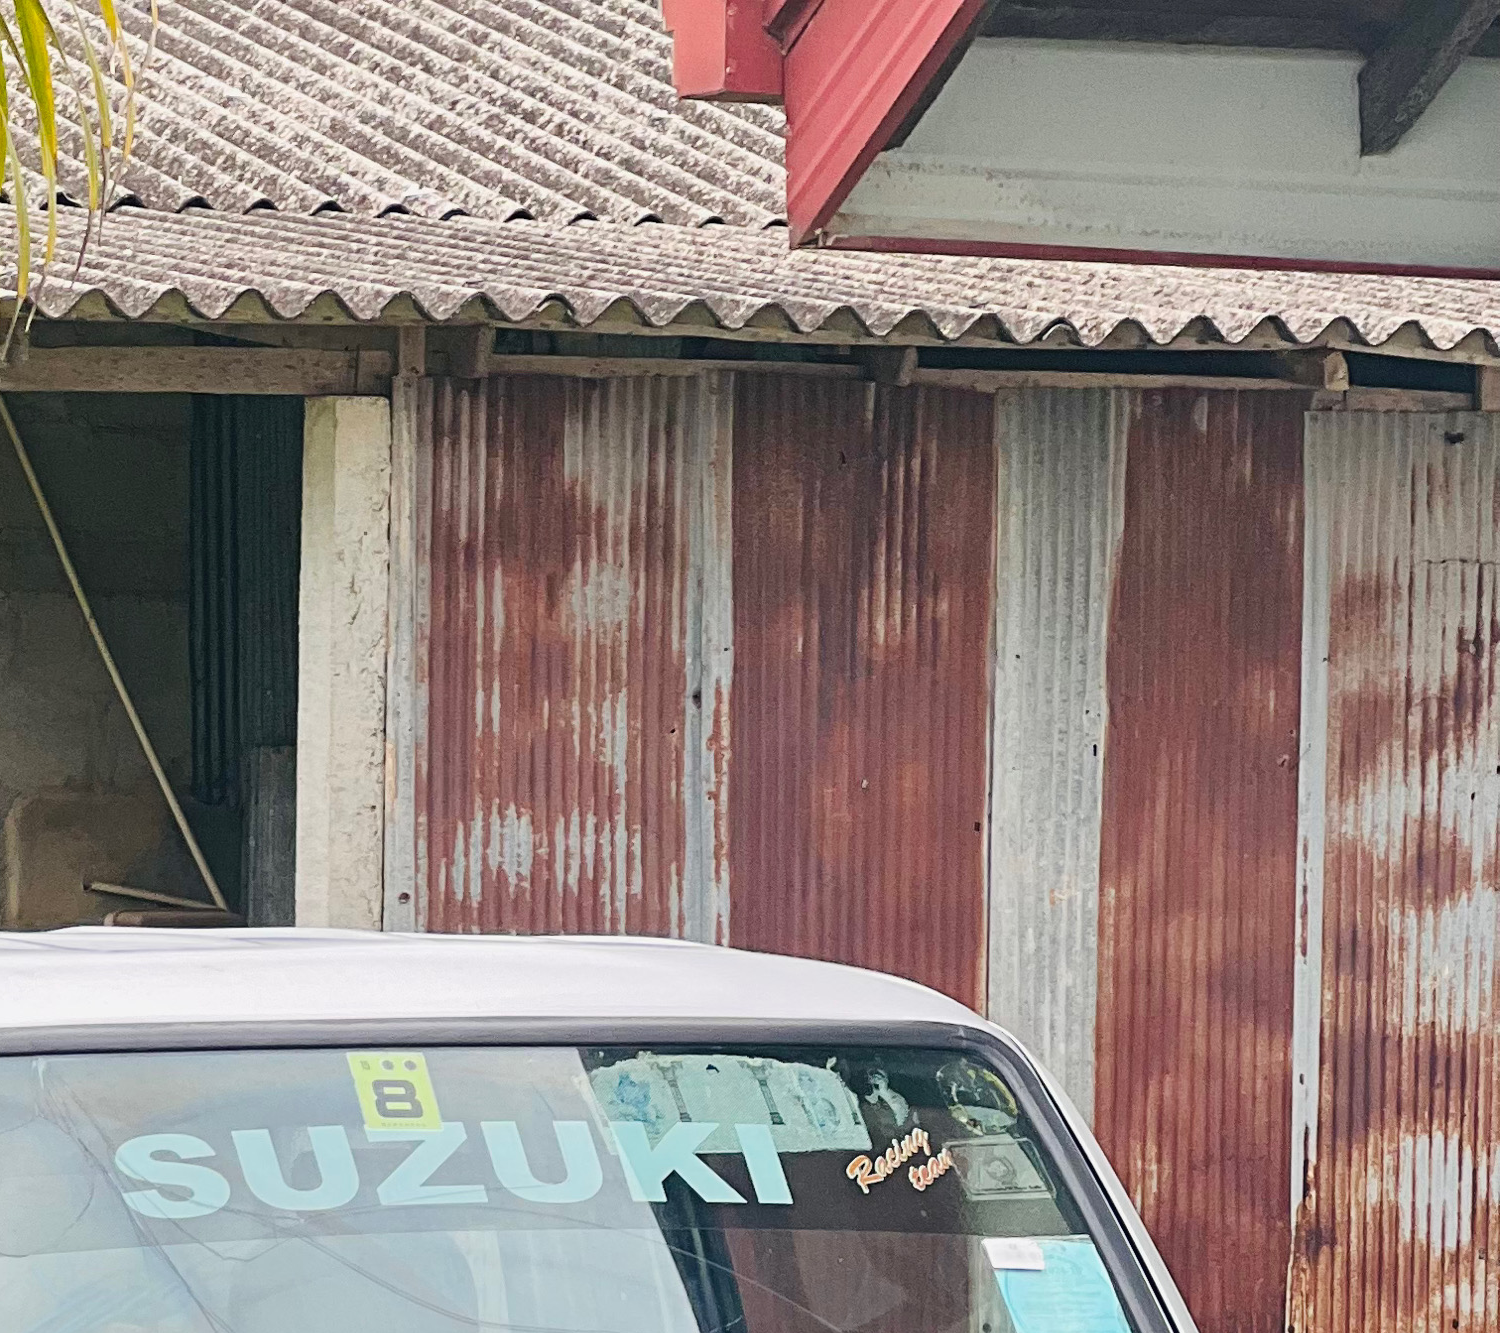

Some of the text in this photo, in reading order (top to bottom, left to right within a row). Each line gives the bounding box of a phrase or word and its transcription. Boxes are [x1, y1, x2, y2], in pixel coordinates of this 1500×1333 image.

[371, 1079, 424, 1119] 8
[115, 1121, 794, 1219] SUZUKI
[845, 1127, 932, 1194] Racing
[908, 1148, 952, 1192] team
